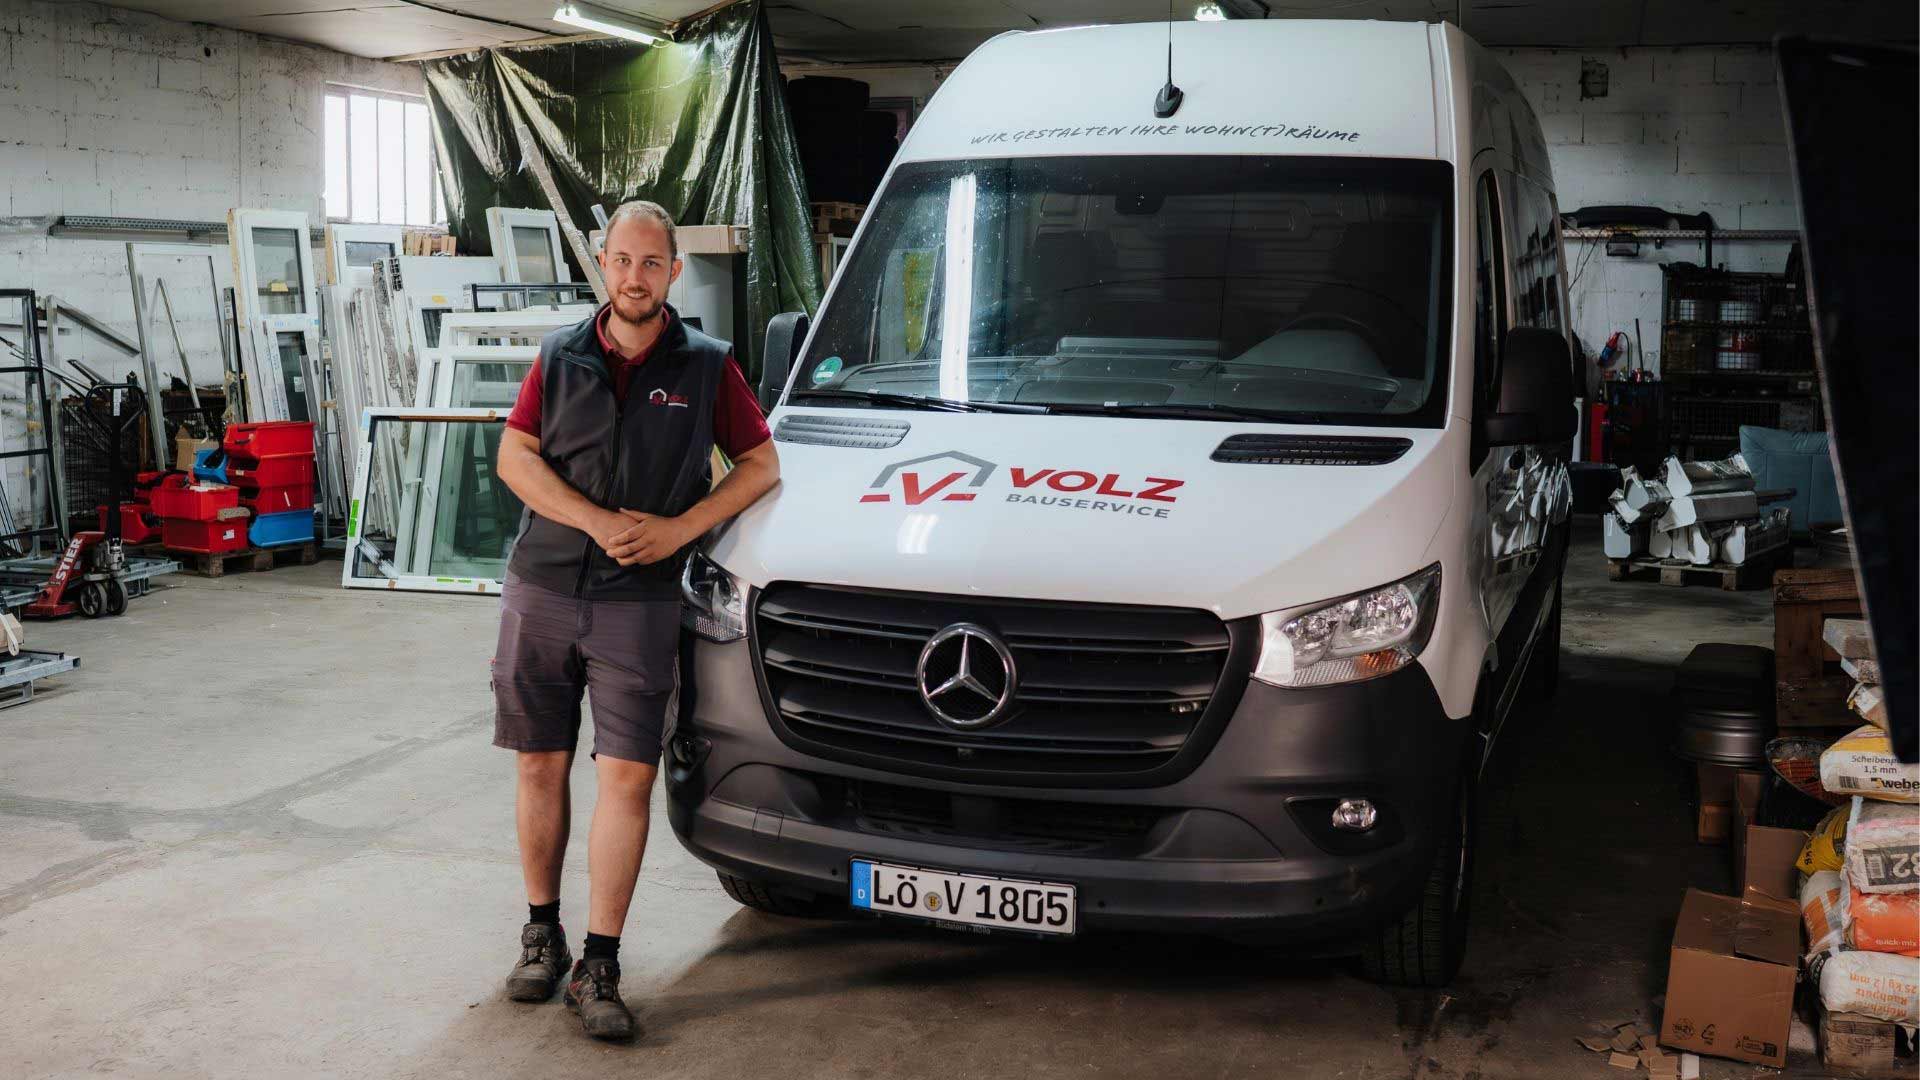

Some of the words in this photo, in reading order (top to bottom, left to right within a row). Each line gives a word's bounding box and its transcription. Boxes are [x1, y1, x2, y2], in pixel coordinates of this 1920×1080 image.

[970, 132, 1008, 145] WIR
[1012, 124, 1129, 143] GESTALTEN
[1130, 124, 1179, 136] IHRE
[1010, 467, 1185, 503] VOLZ
[1005, 493, 1171, 519] BAUSERVICE
[55, 537, 83, 581] STIER
[1851, 755, 1898, 767] Scheibenp
[1863, 766, 1877, 774] 1,5
[857, 888, 866, 900] D
[873, 870, 918, 908] LÖ
[944, 879, 966, 915] V
[975, 884, 1068, 926] 1805
